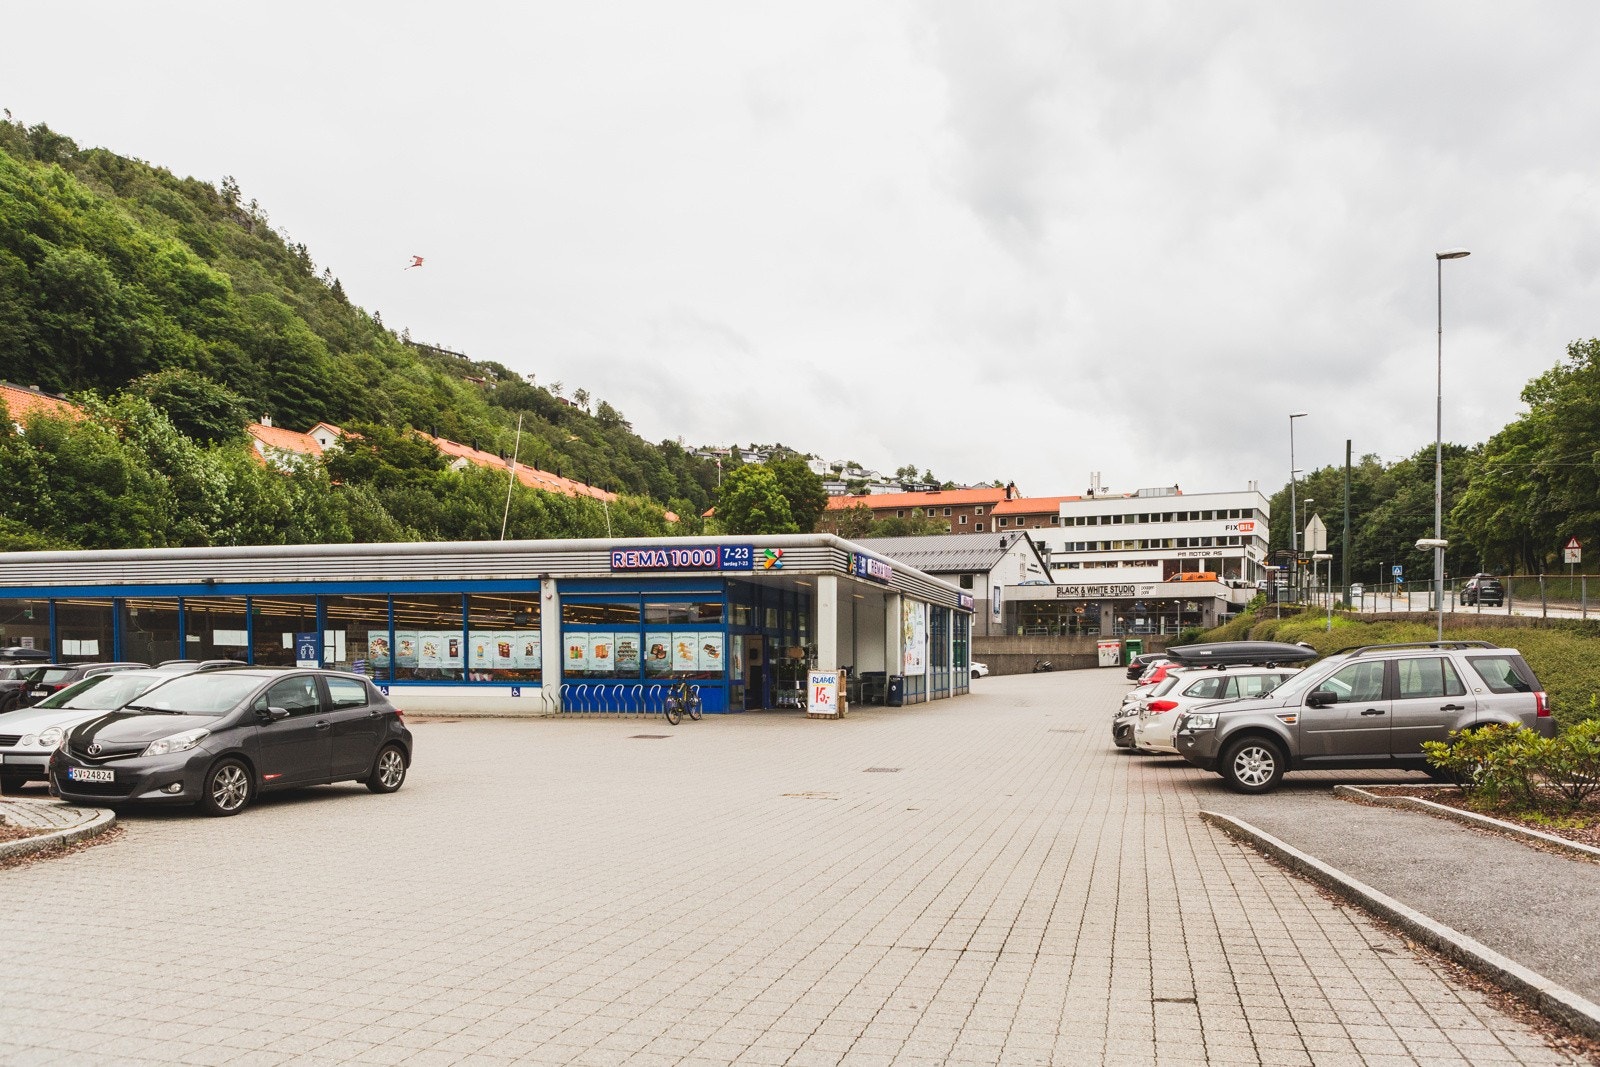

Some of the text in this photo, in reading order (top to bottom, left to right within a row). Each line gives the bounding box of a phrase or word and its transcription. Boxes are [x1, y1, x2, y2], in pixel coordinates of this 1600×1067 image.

[612, 549, 716, 567] REMA 1000
[723, 547, 749, 559] 7-23
[1056, 586, 1079, 594] BLACK
[1080, 586, 1086, 594] &
[1087, 585, 1108, 593] WHITE
[1110, 584, 1136, 593] STUDIO
